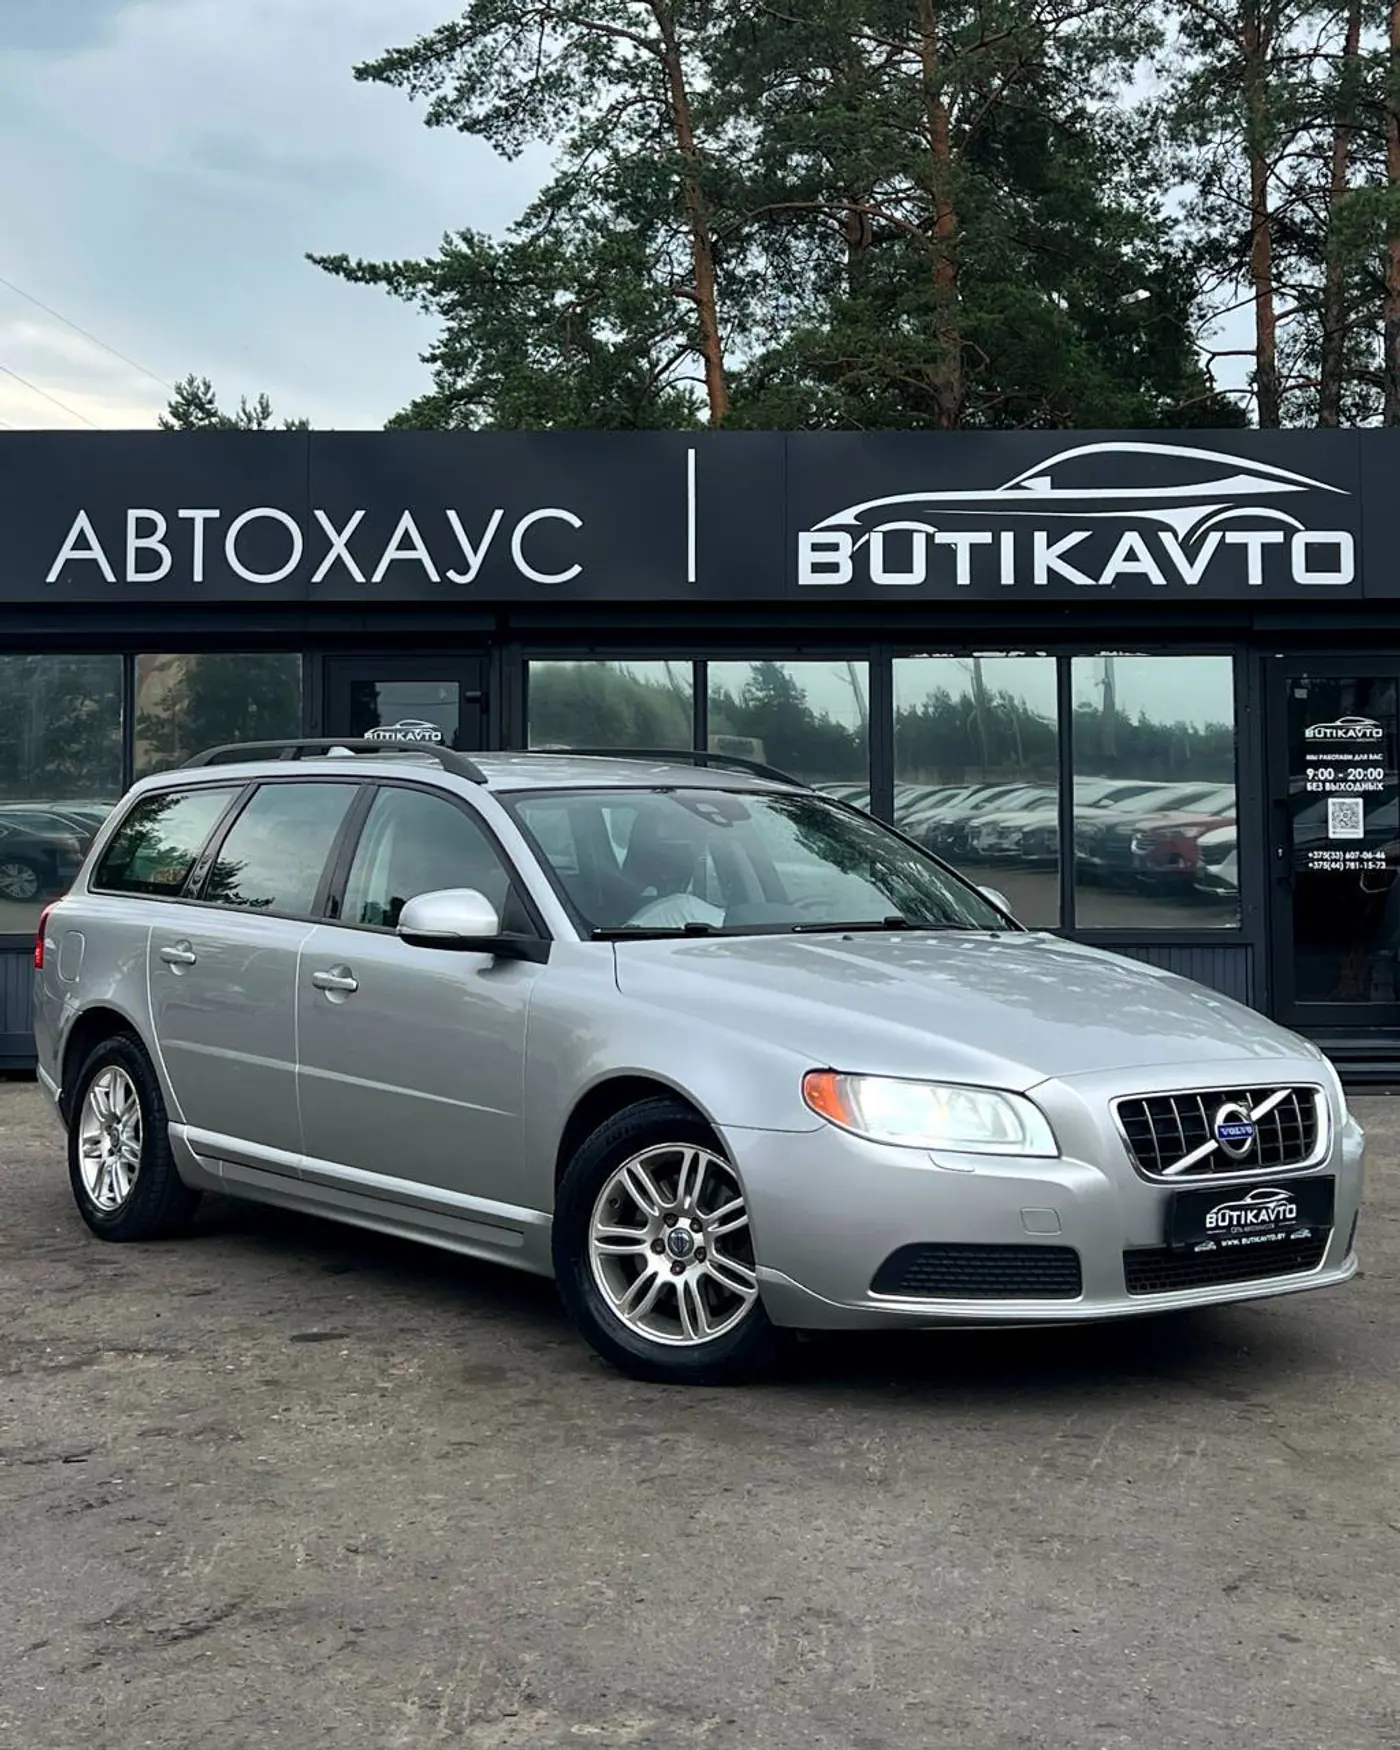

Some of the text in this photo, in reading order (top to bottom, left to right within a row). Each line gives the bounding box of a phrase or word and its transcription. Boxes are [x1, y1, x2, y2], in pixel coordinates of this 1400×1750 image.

[46, 507, 583, 584] АВТОХАУС
[798, 531, 1355, 585] BUTIKAVTO
[1305, 728, 1383, 739] BUTIKAVTO
[1306, 767, 1335, 781] 9:00
[1347, 767, 1384, 781] 20:00
[1306, 781, 1384, 792] БЕЗ ВЫХОДНЫХ
[1220, 1126, 1253, 1136] VOLVO
[1206, 1204, 1296, 1228] BUTIKAVTO
